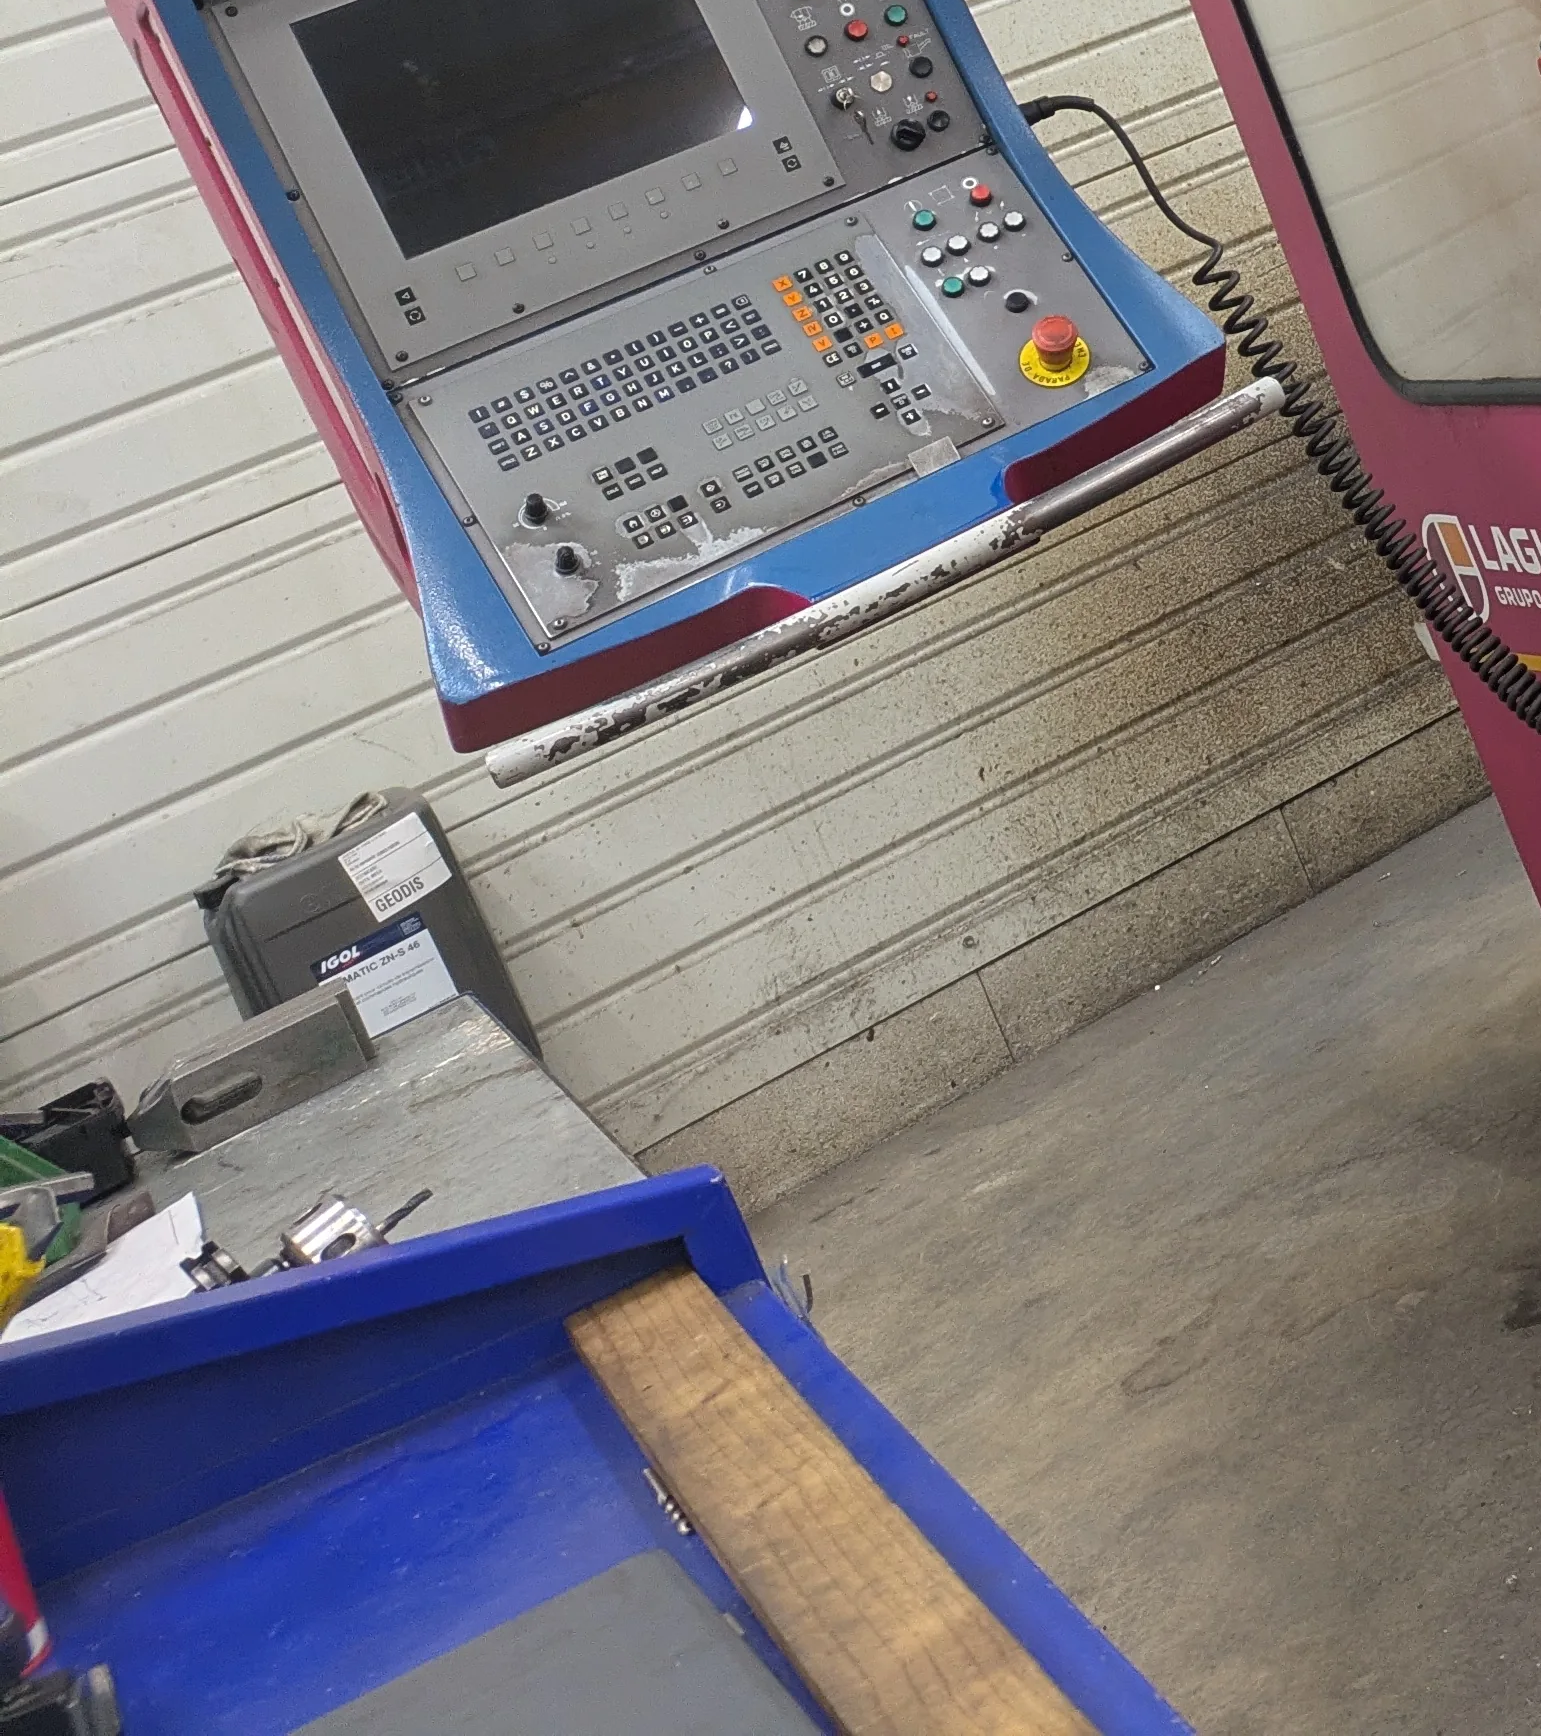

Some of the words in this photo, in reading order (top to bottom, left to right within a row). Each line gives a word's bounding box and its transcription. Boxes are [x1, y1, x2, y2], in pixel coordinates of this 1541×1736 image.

[797, 270, 807, 279] 7
[839, 253, 849, 262] 9
[809, 285, 819, 294] 4
[828, 276, 839, 285] 5
[838, 291, 849, 300] 2
[859, 282, 869, 291] 3
[797, 309, 808, 318] Z
[828, 315, 838, 324] 0
[826, 352, 840, 364] CE
[507, 415, 517, 424] Q
[527, 405, 539, 415] W
[552, 396, 562, 405] E
[573, 386, 583, 396] R
[596, 377, 604, 386] T
[617, 367, 626, 376] Y
[639, 358, 649, 367] U
[682, 340, 692, 348] O
[703, 330, 713, 340] P
[519, 389, 529, 400] $
[540, 381, 554, 390] %
[586, 362, 597, 371] &
[1033, 372, 1070, 383] PARADA
[517, 432, 526, 441] A
[539, 422, 549, 431] S
[561, 412, 571, 421] D
[583, 402, 591, 412] F
[606, 393, 615, 402] G
[627, 383, 638, 393] H
[671, 364, 681, 373] K
[693, 356, 702, 364] L
[525, 447, 538, 457] Z
[548, 437, 560, 447] X
[571, 428, 581, 436] C
[593, 418, 602, 427] V
[615, 408, 625, 417] B
[637, 398, 648, 408] N
[658, 388, 670, 399] M
[374, 876, 425, 913] GEODIS
[321, 945, 361, 975] IGOL
[379, 948, 406, 966] ZN-S
[407, 940, 421, 952] 46
